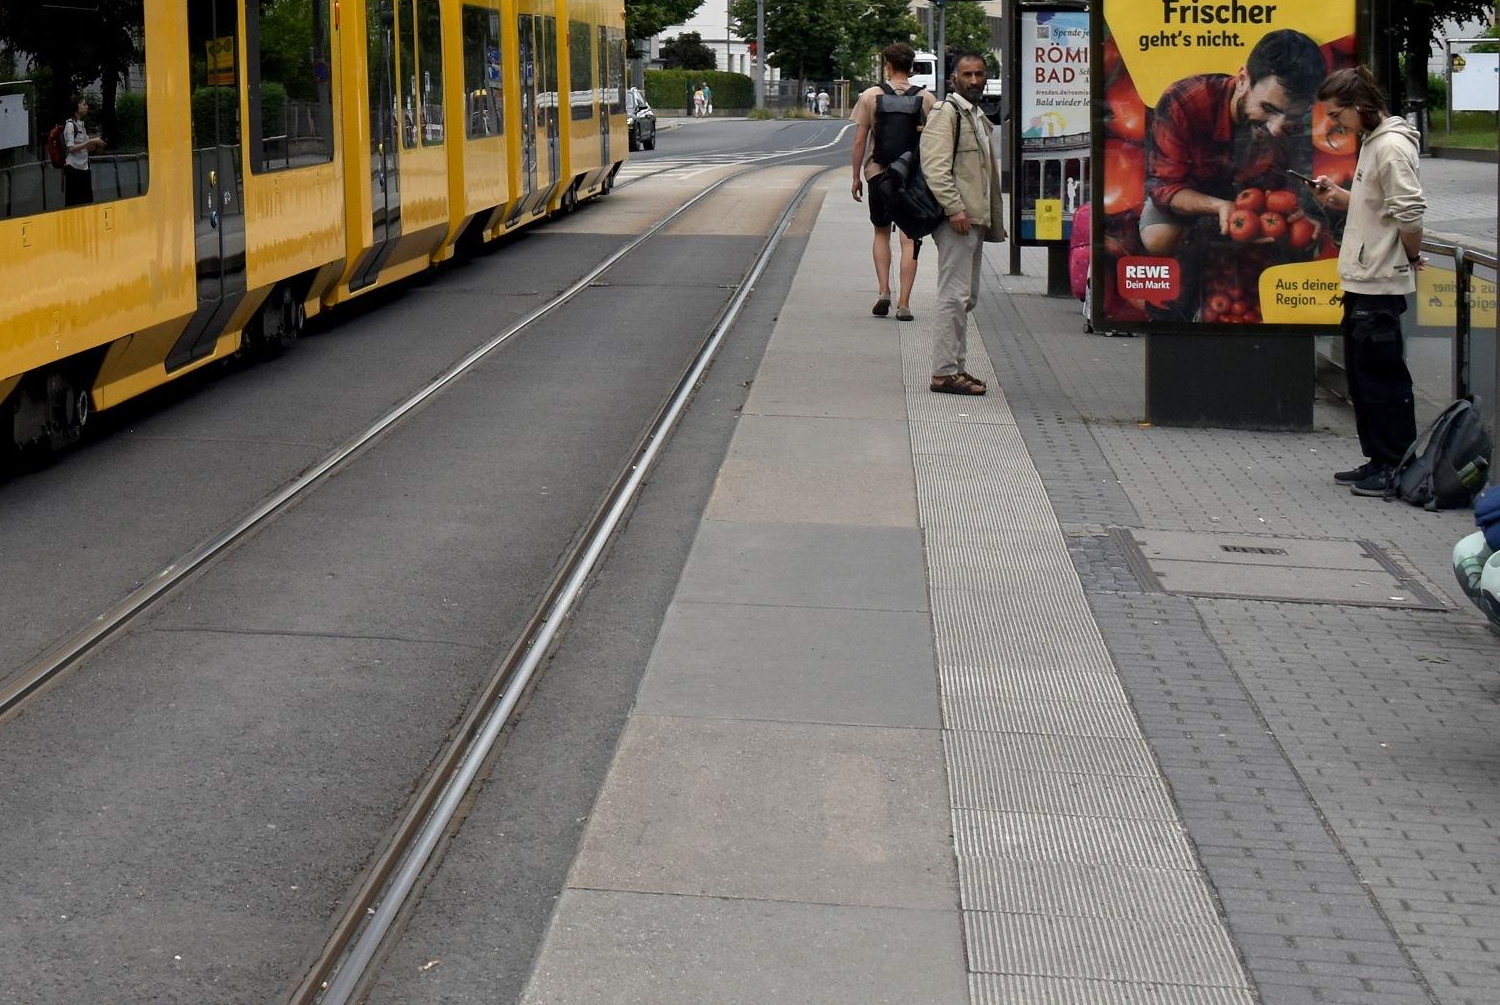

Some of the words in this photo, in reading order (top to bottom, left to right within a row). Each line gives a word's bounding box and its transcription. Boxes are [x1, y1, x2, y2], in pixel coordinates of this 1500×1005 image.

[1053, 28, 1082, 38] Spende
[1196, 30, 1245, 47] nicht.
[1035, 67, 1076, 83] BAD
[1035, 98, 1054, 107] Bald
[1055, 98, 1082, 107] wieder
[1125, 265, 1170, 279] REWE
[1125, 280, 1144, 289] Dein
[1145, 280, 1170, 290] Markt
[1276, 279, 1299, 291] Aus
[1302, 278, 1339, 291] deiner
[1276, 294, 1316, 309] Region
